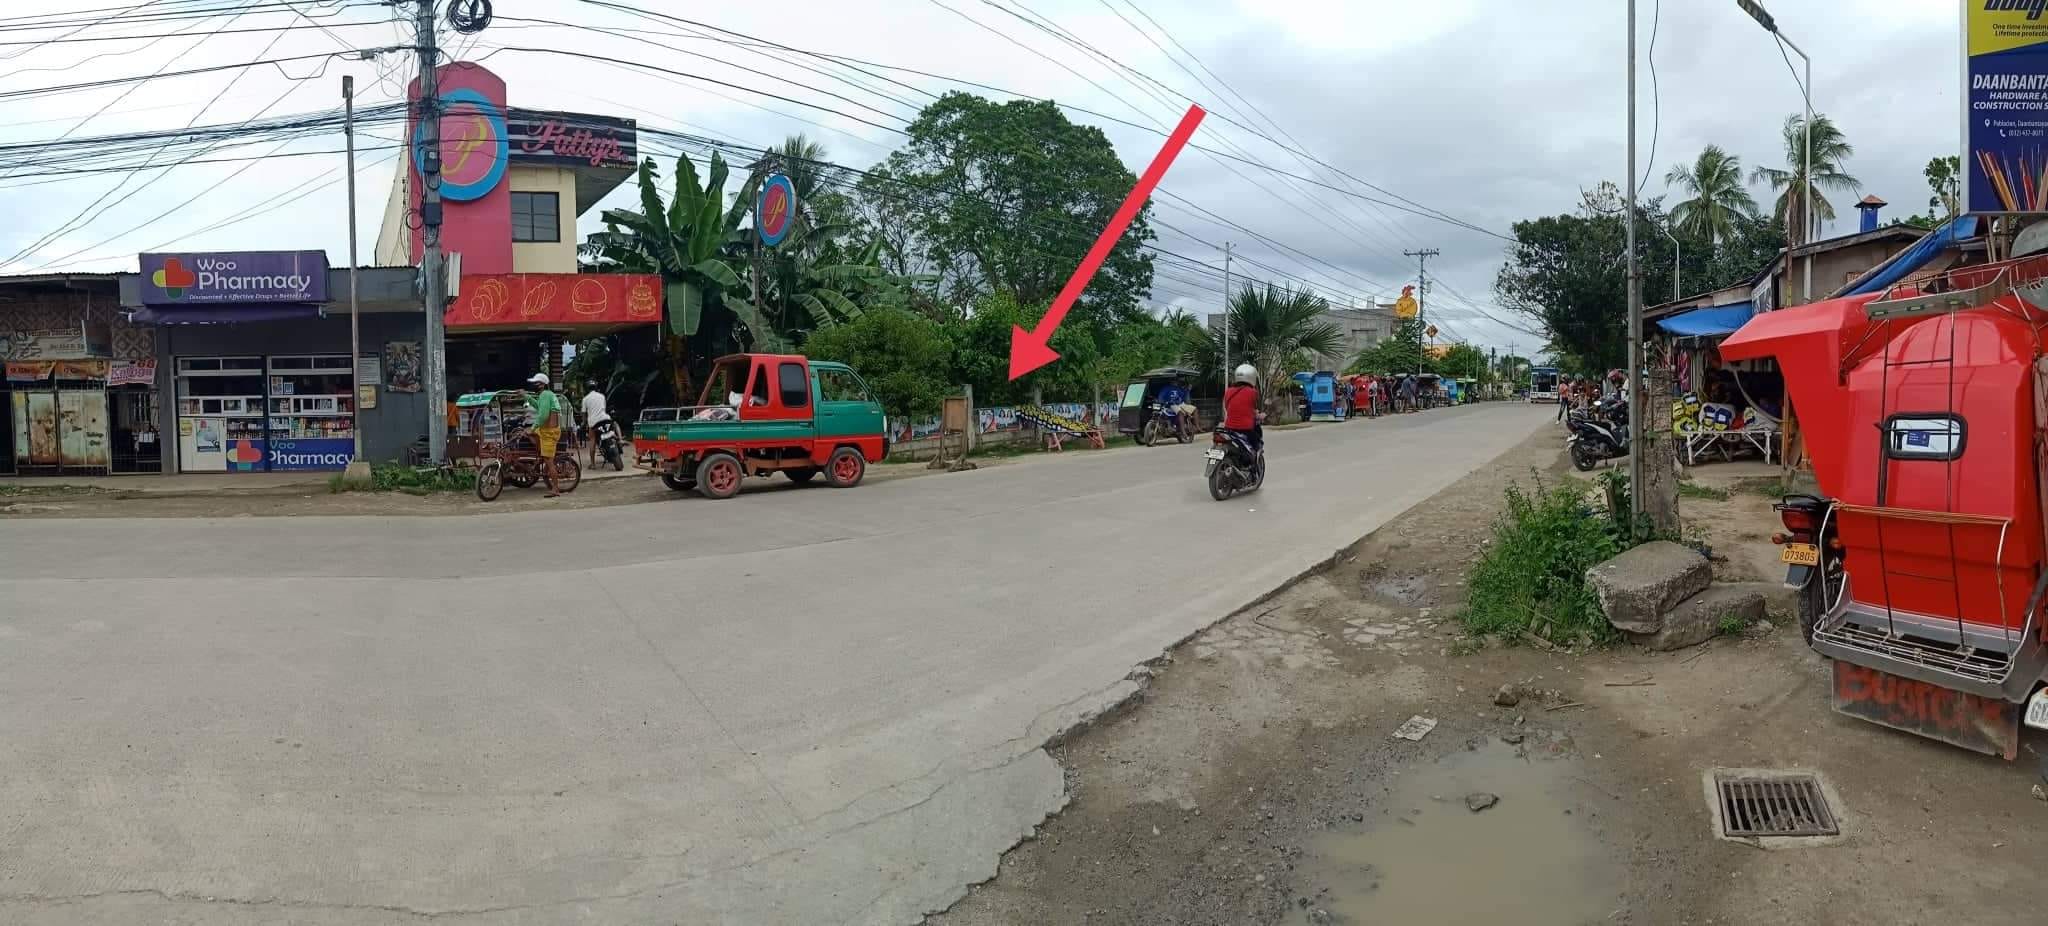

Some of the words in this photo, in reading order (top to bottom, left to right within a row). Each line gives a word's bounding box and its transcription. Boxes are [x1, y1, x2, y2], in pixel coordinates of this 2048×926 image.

[1989, 92, 2041, 100] HARDWARE
[1973, 101, 2043, 110] CONSTRUCTION
[197, 258, 237, 271] Woo
[198, 271, 311, 292] Pharmacy
